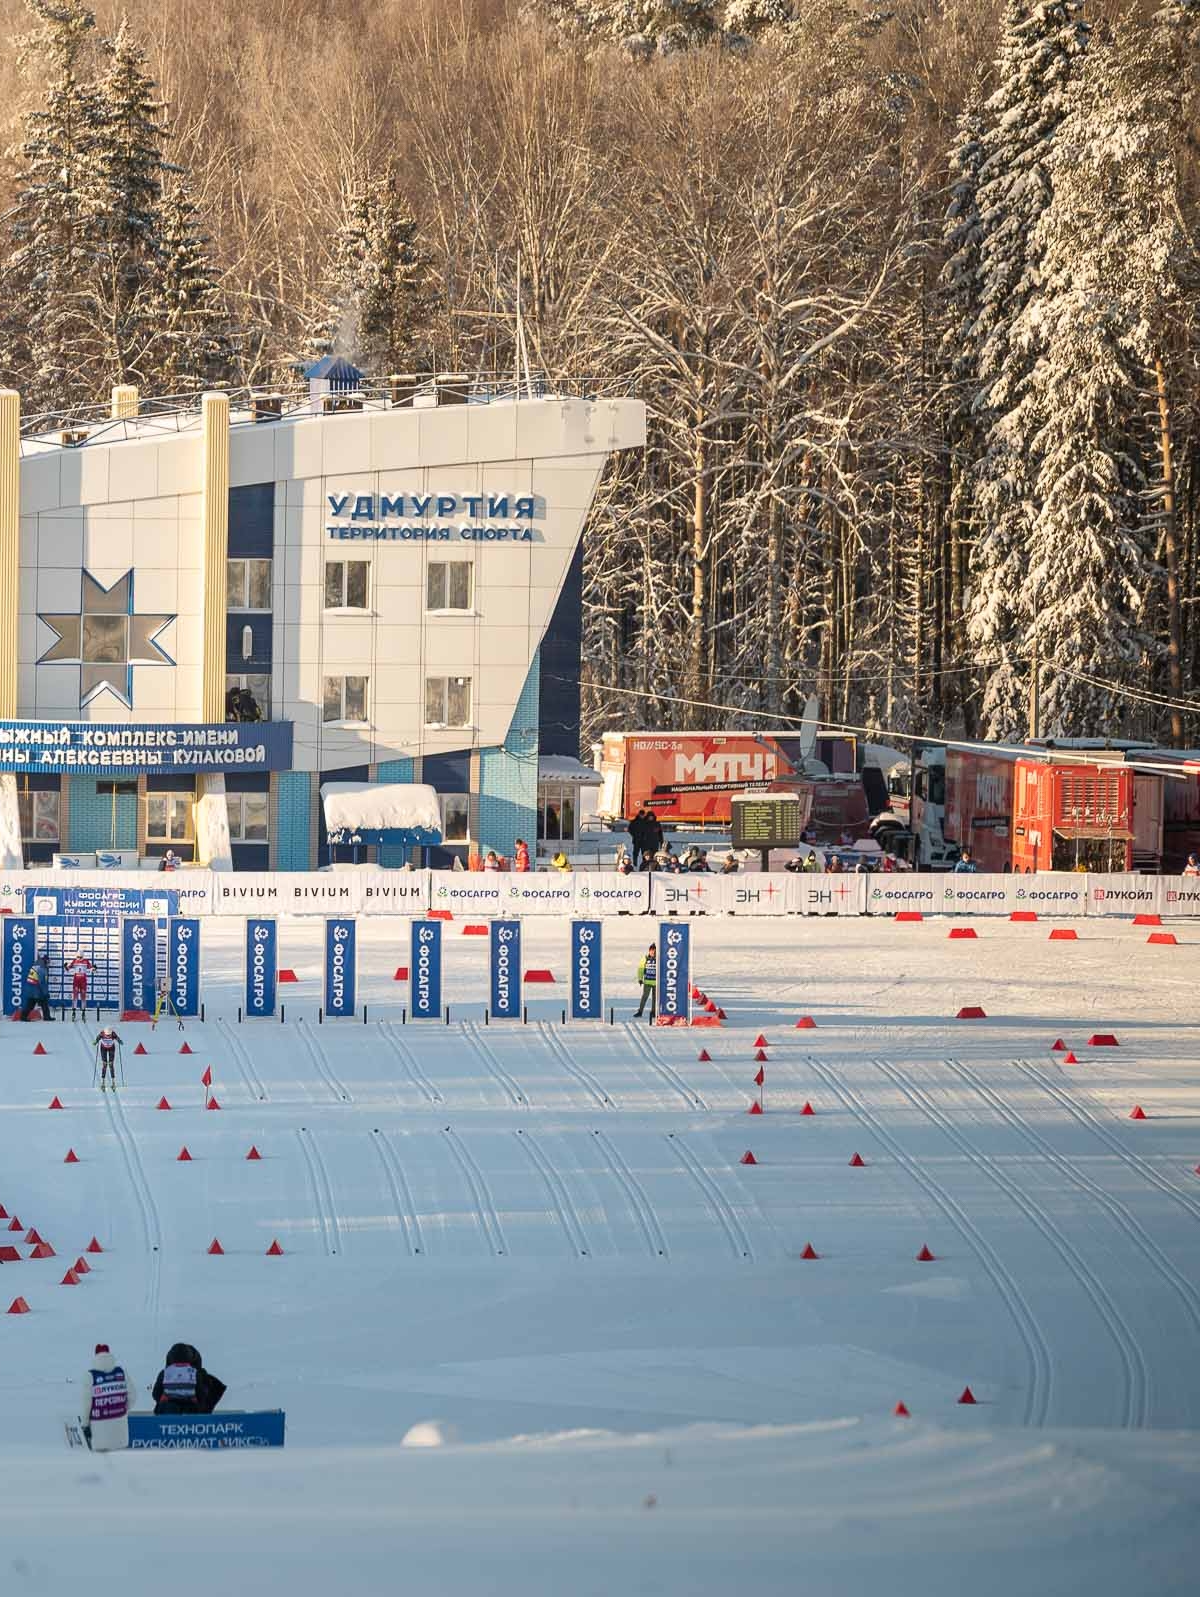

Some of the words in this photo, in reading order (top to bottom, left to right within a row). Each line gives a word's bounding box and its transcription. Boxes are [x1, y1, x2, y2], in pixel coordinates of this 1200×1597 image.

[327, 495, 535, 521] УДМУРТИЯ
[326, 526, 450, 541] ТЕРРИТОРИЯ
[460, 527, 533, 541] СПОРТА
[83, 729, 177, 747] КОМПЛЕКС
[183, 730, 238, 745] ИМЕНИ
[40, 750, 162, 766] АЛЕКСЕЕВНЫ
[173, 745, 265, 765] КУЛАКОВОЙ
[78, 892, 126, 900] ФОСАГРО
[180, 889, 206, 898] АГРО
[222, 887, 278, 897] BIVIUM
[294, 887, 349, 897] BIVIUM
[366, 887, 420, 897] BIVIUM
[450, 889, 500, 899] ФОСАГРО
[522, 889, 571, 899] ФОСАГРО
[593, 889, 643, 899] ФОСАГРО
[884, 890, 934, 900] ФОСАГРО
[956, 890, 1006, 900] ФОСАГРО
[1029, 890, 1079, 900] ФОСАГРО
[1105, 888, 1153, 901] ЛУКОЙЛ
[11, 943, 23, 1007] ФОСАГРО
[132, 943, 143, 1007] ФОСАГРО
[176, 943, 187, 1007] ФОСАГРО
[253, 943, 264, 1009] ФОСАГРО
[333, 943, 344, 1009] ФОСАГРО
[418, 944, 430, 1010] ФОСАГРО
[498, 944, 509, 1010] ФОСАГРО
[579, 944, 590, 1010] ФОСАГРО
[666, 947, 678, 1012] ФОСАГРО
[159, 1423, 244, 1436] ТЕХНОПАРК
[131, 1437, 217, 1449] РУСКЛИМАТ
